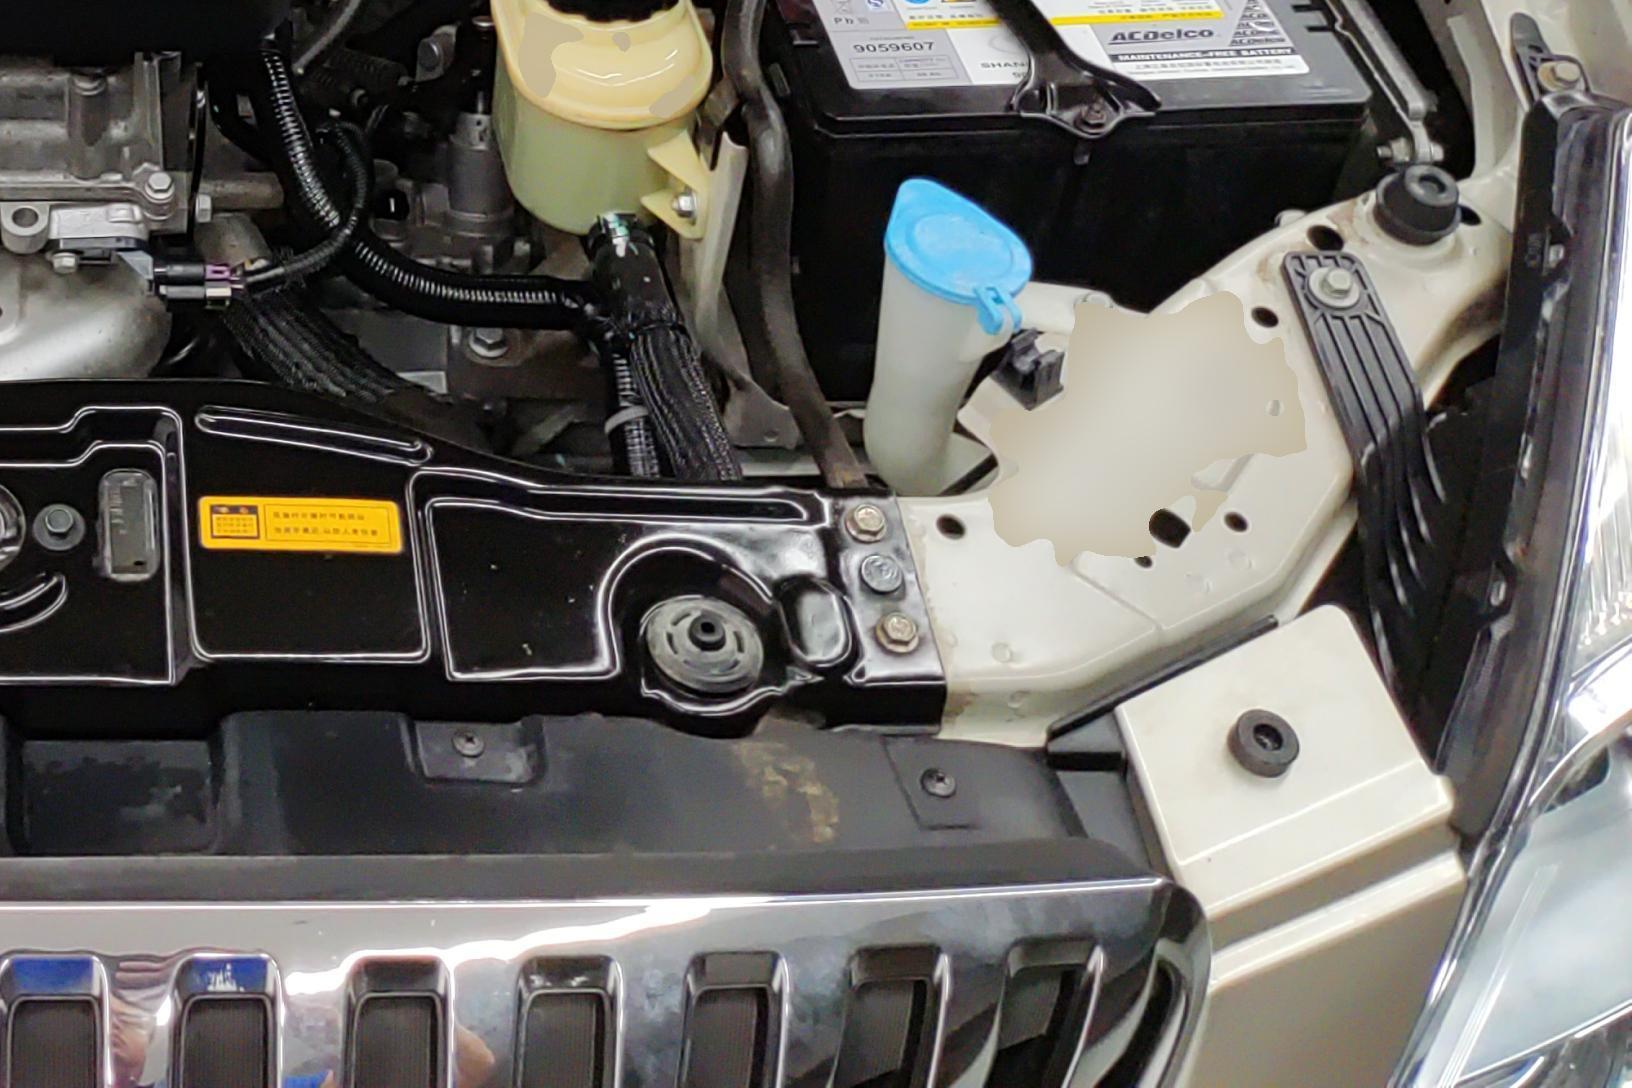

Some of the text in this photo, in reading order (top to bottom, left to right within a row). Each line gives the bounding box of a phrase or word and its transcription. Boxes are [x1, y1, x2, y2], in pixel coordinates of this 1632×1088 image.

[1110, 28, 1215, 43] ACDelco
[853, 40, 936, 54] 9059607
[1241, 47, 1293, 57] BATTERY
